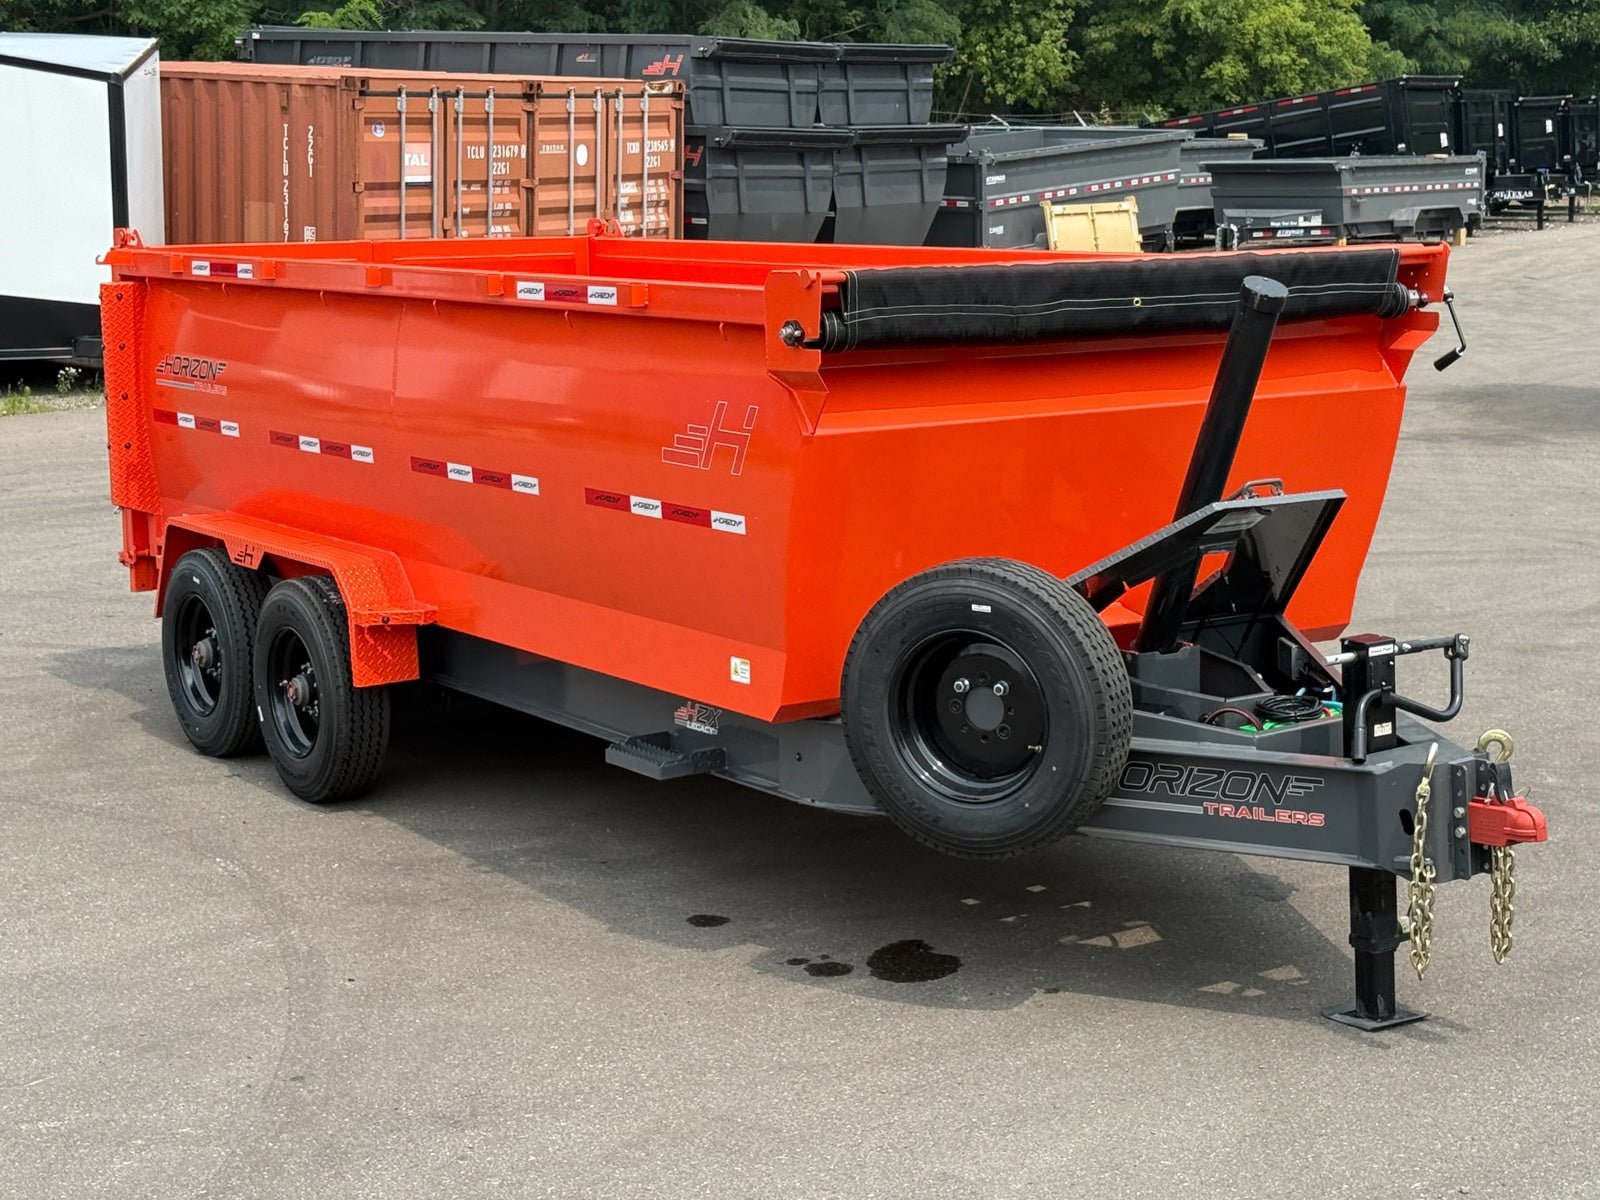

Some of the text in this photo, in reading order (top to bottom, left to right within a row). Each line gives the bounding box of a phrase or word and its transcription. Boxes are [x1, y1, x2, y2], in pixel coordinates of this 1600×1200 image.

[467, 145, 485, 159] TCLU
[492, 145, 519, 159] 231679
[162, 354, 220, 382] HORIZON
[1117, 761, 1294, 805] ORIZON
[1202, 801, 1326, 827] TRAILERS
